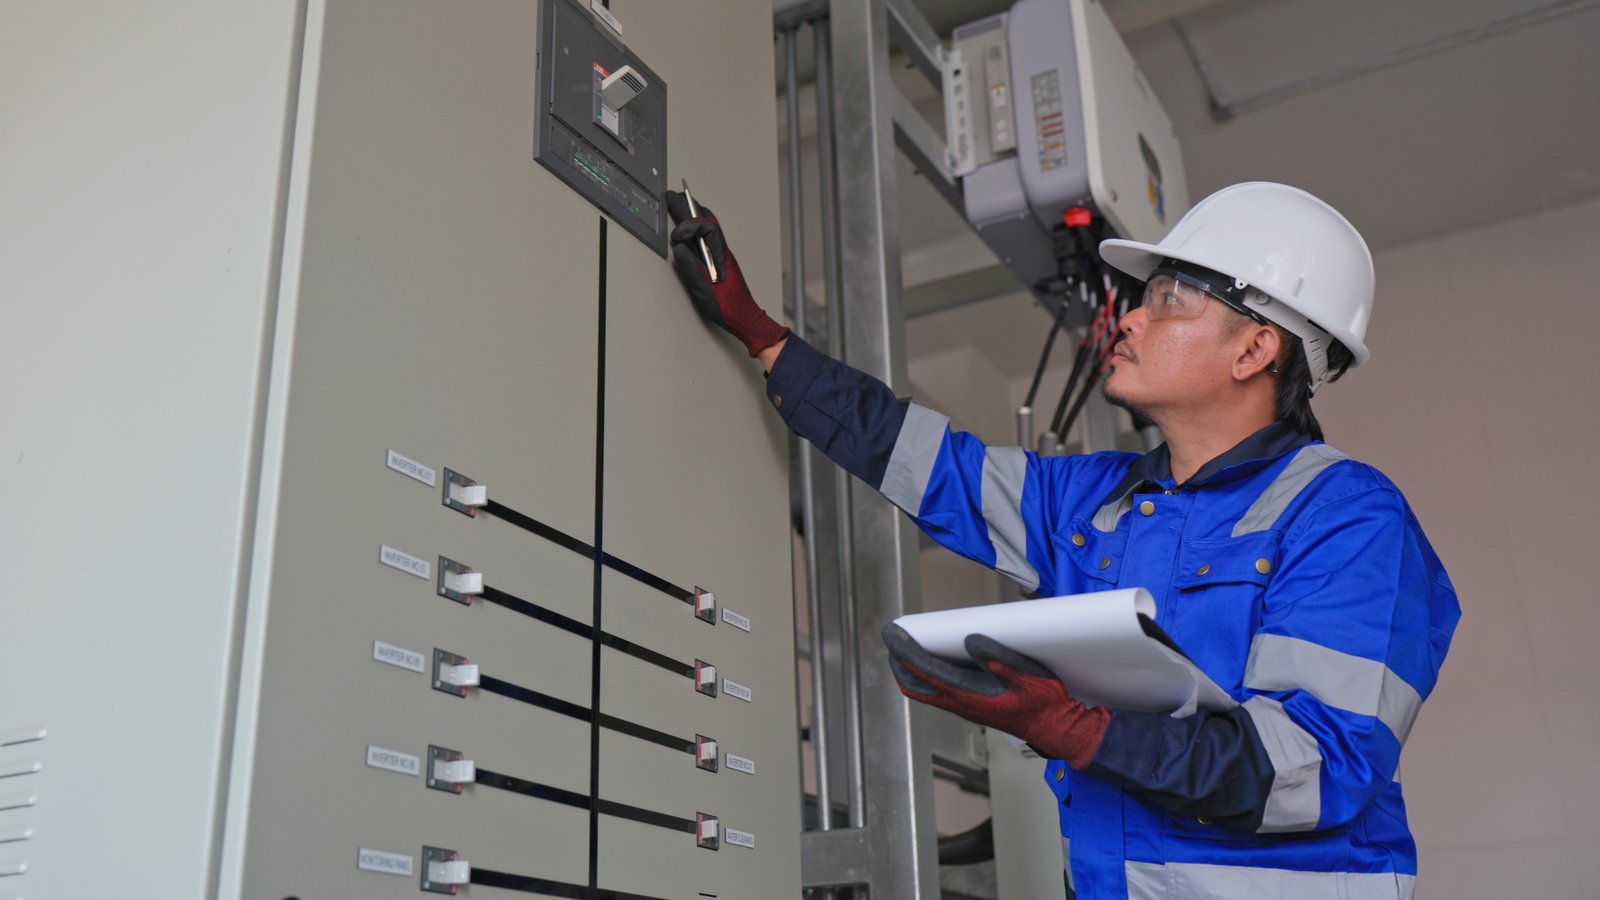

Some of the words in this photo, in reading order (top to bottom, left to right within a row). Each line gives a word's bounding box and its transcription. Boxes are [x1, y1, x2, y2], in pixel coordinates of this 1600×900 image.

[391, 455, 417, 473] INVERTER
[384, 550, 410, 568] INVERTER
[378, 645, 405, 662] INVERTER
[372, 750, 399, 766] INVERTER
